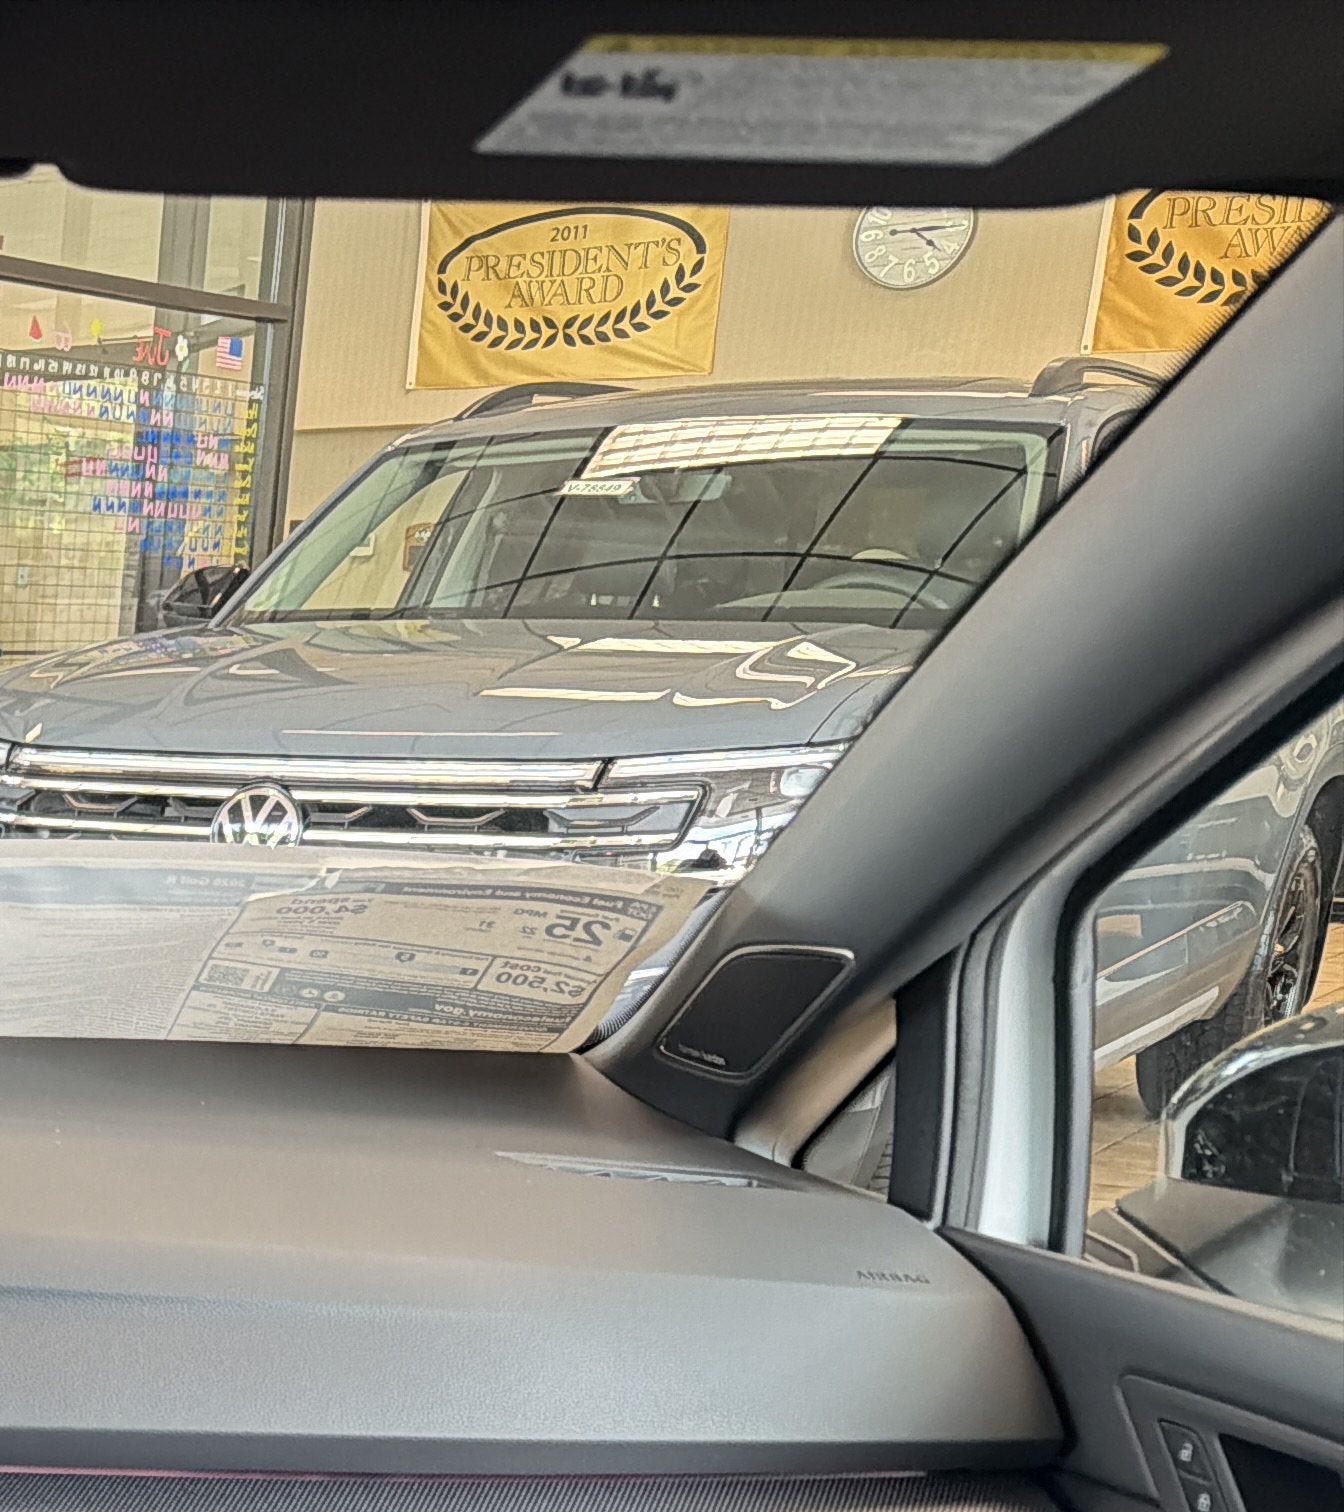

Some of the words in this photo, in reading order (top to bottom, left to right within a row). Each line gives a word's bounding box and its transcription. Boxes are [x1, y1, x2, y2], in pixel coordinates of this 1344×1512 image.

[550, 224, 589, 242] 2011
[861, 230, 883, 242] 9
[462, 237, 682, 282] PRESIDENT'S
[865, 245, 886, 262] 8
[923, 251, 940, 274] 5
[879, 254, 899, 278] 7
[904, 259, 916, 282] 6
[504, 273, 624, 309] AWARD
[855, 1265, 931, 1284] AIRBAG
